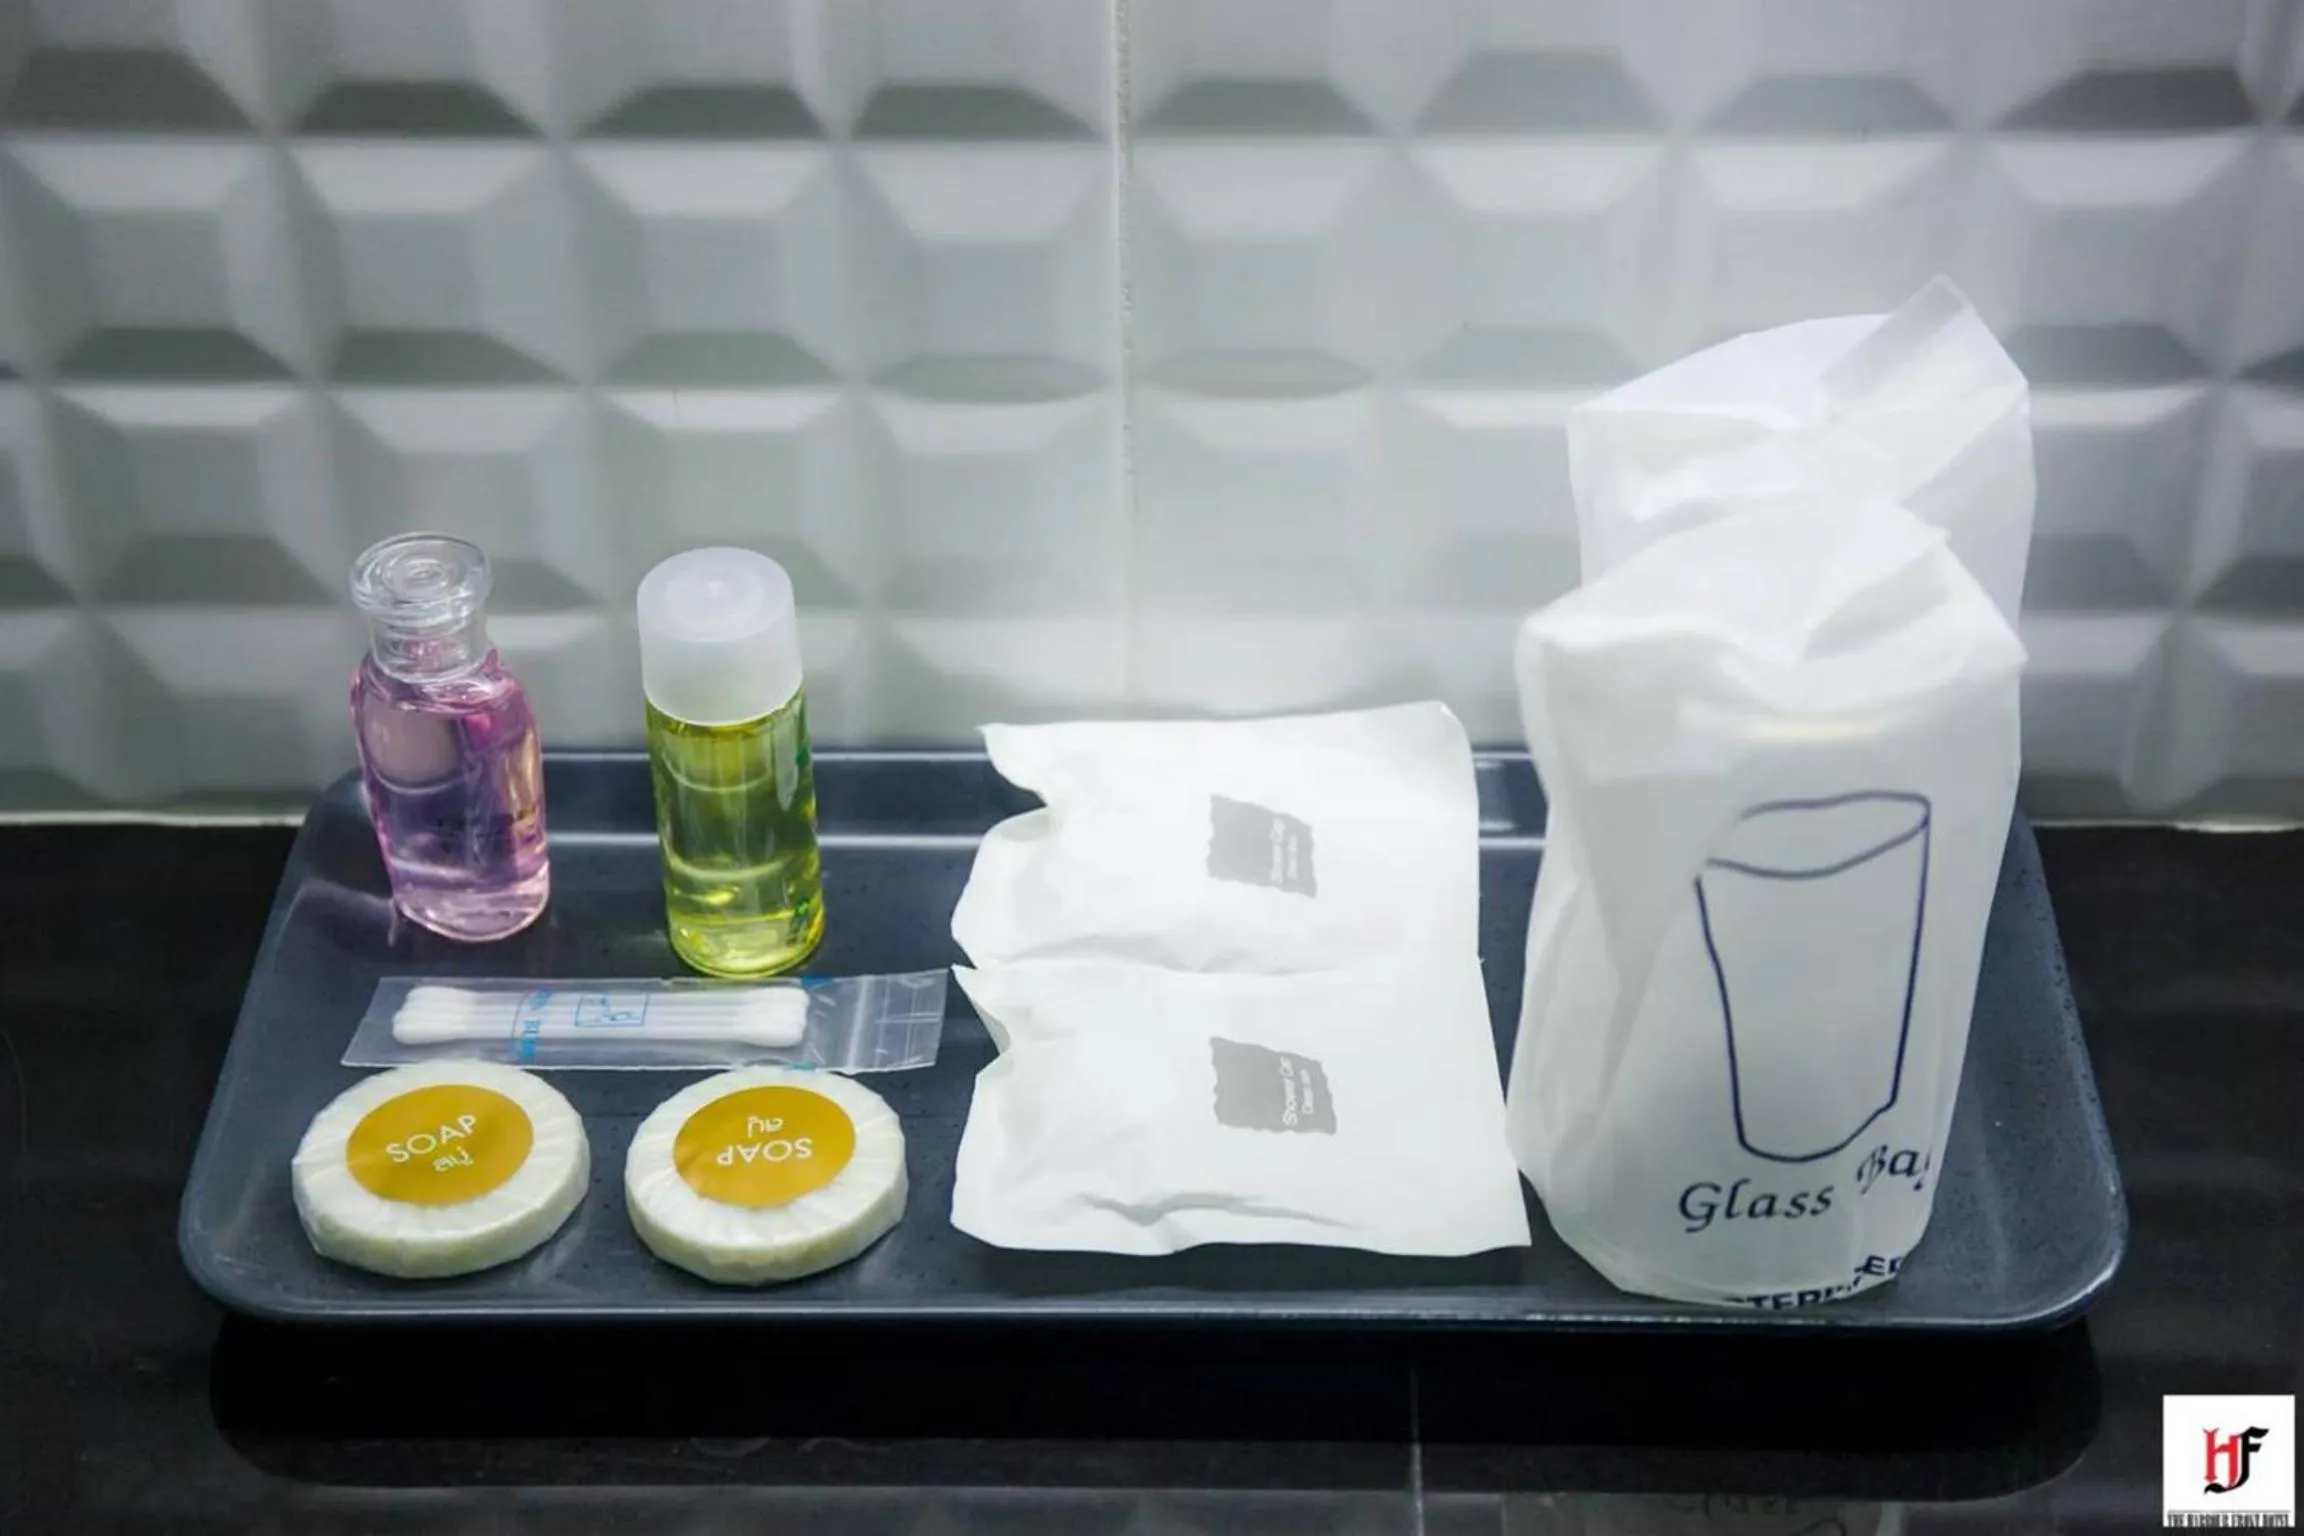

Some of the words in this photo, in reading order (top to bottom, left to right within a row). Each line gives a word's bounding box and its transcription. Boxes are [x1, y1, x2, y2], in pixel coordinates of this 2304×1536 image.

[385, 1114, 477, 1164] SOAP
[715, 1137, 813, 1167] SOAP
[1678, 1178, 1835, 1233] Glass
